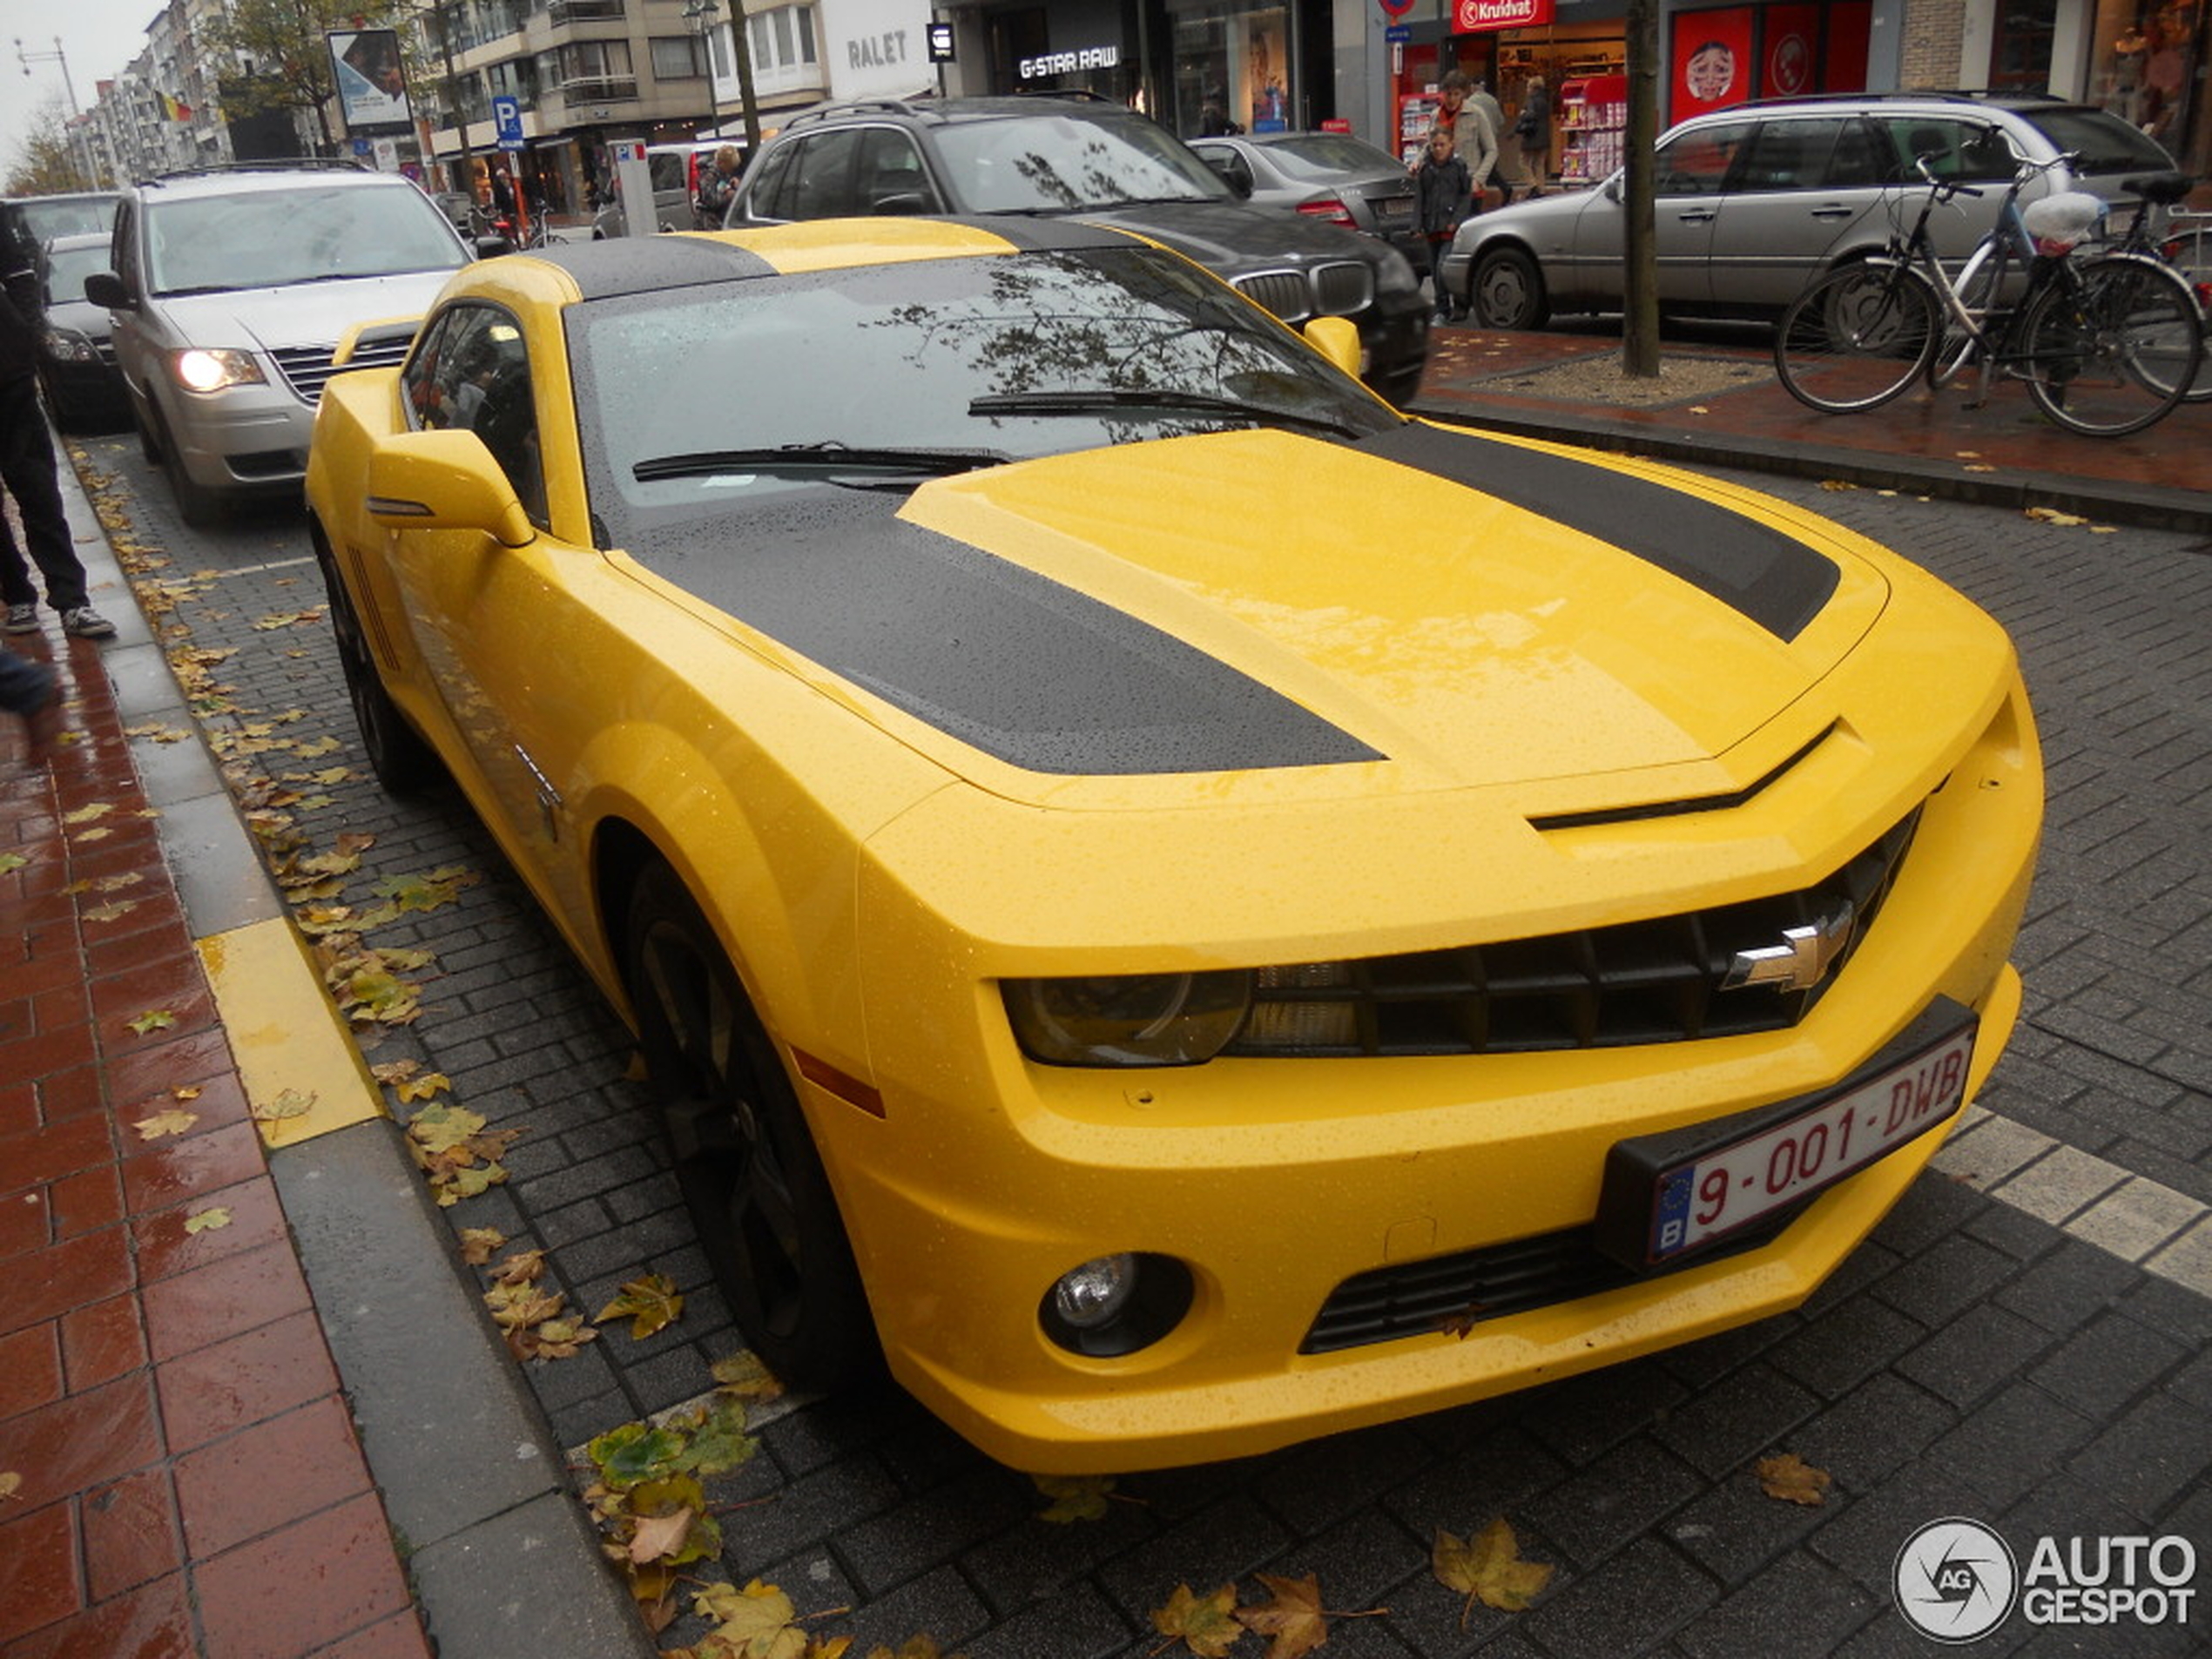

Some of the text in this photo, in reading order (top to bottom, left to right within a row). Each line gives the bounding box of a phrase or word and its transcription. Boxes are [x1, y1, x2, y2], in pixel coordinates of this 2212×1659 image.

[847, 30, 907, 69] RALET
[1079, 46, 1116, 70] RAW
[496, 103, 516, 132] P
[1661, 1219, 1682, 1249] B
